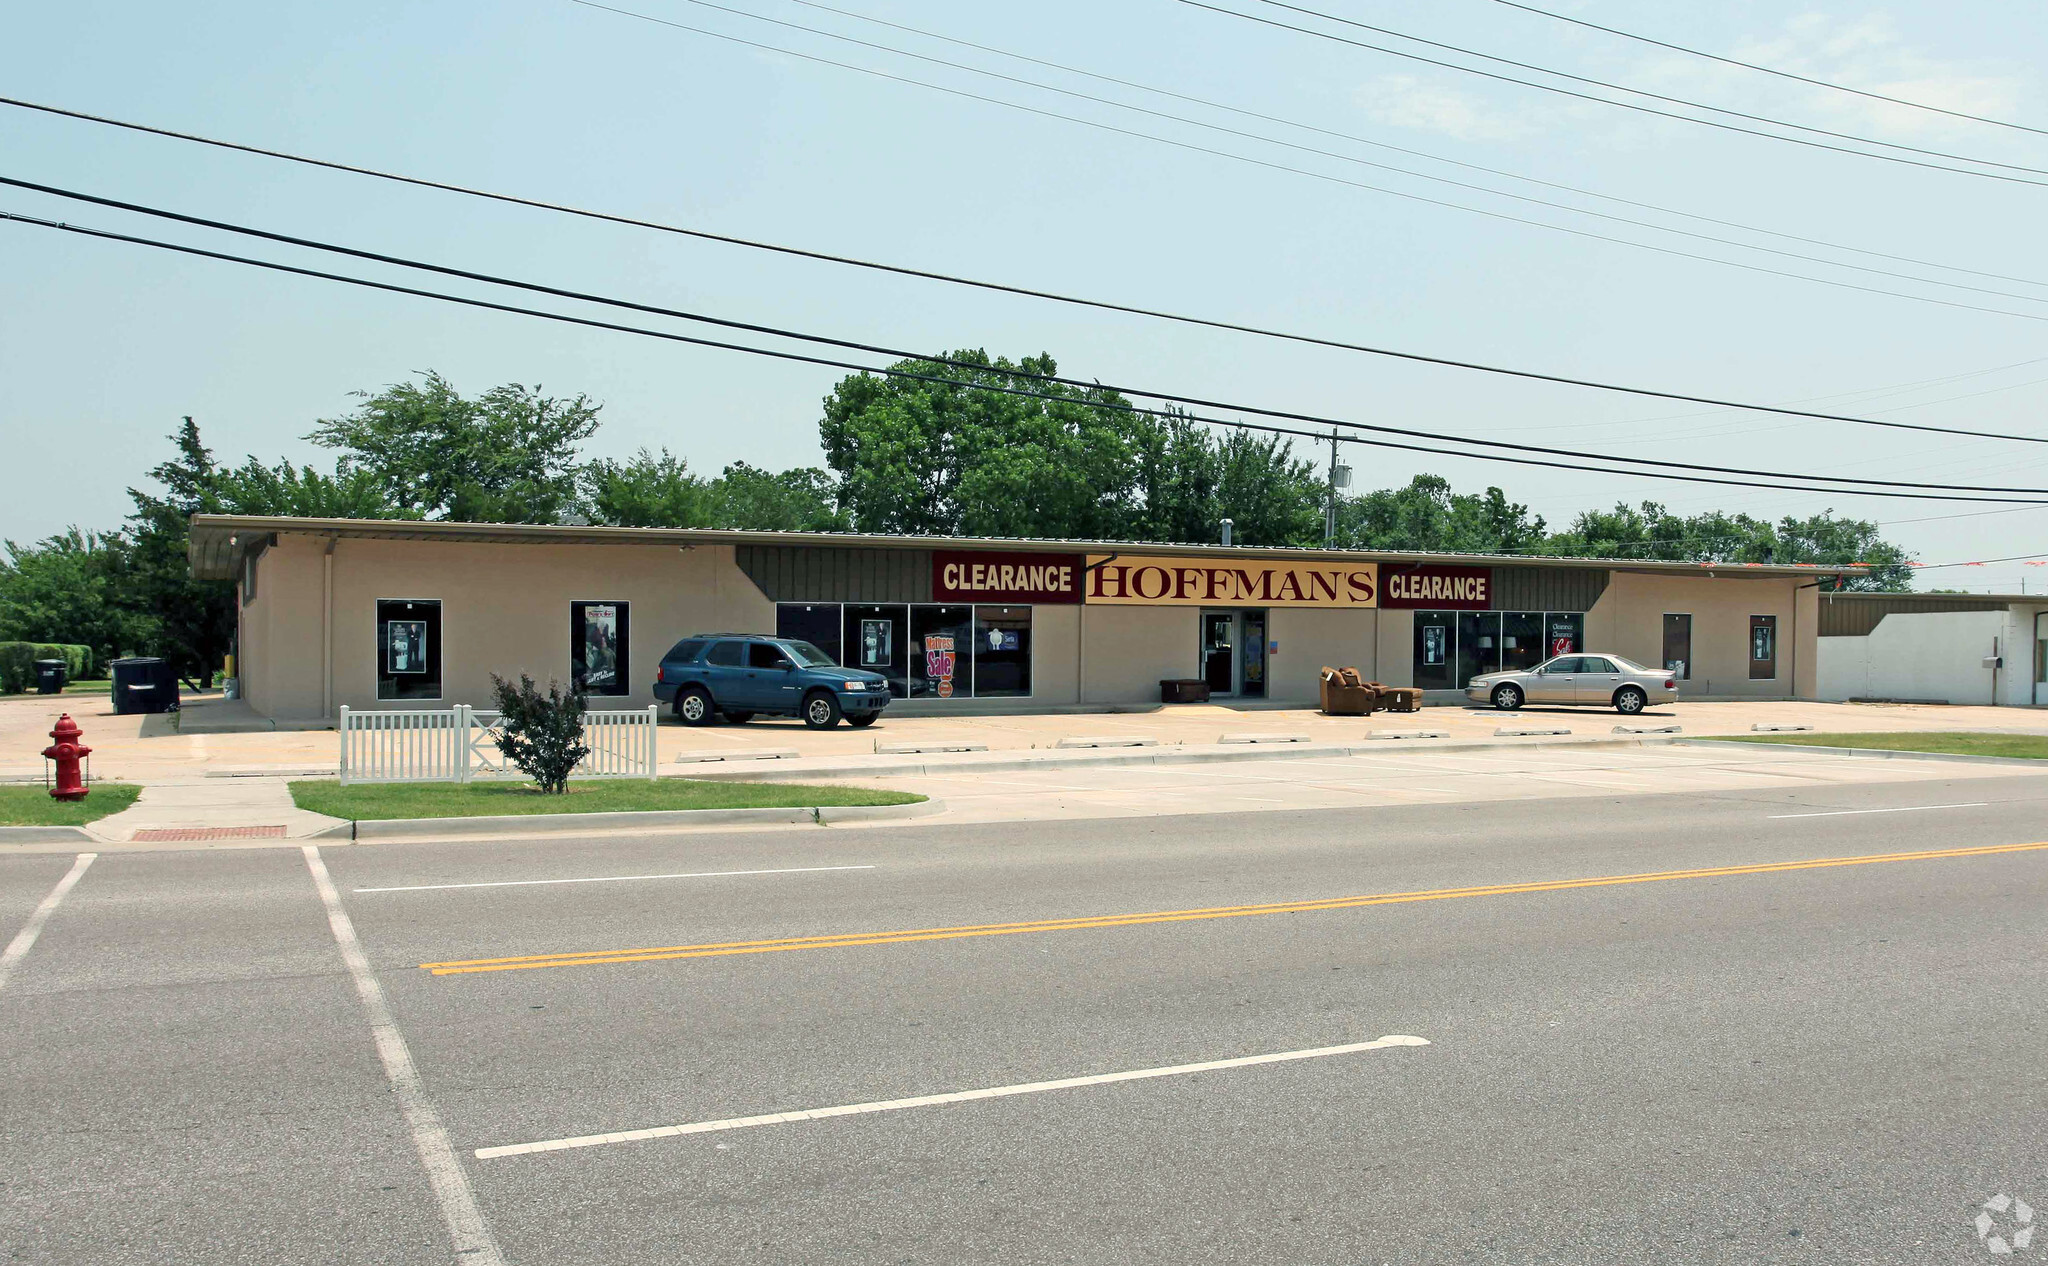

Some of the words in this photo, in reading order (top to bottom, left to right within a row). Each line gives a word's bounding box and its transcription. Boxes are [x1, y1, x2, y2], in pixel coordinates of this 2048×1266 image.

[943, 563, 1072, 591] CLEARANCE
[1088, 566, 1374, 602] HOFFMAN'S
[1389, 574, 1486, 601] CLEARANCE
[925, 636, 954, 651] Mattress
